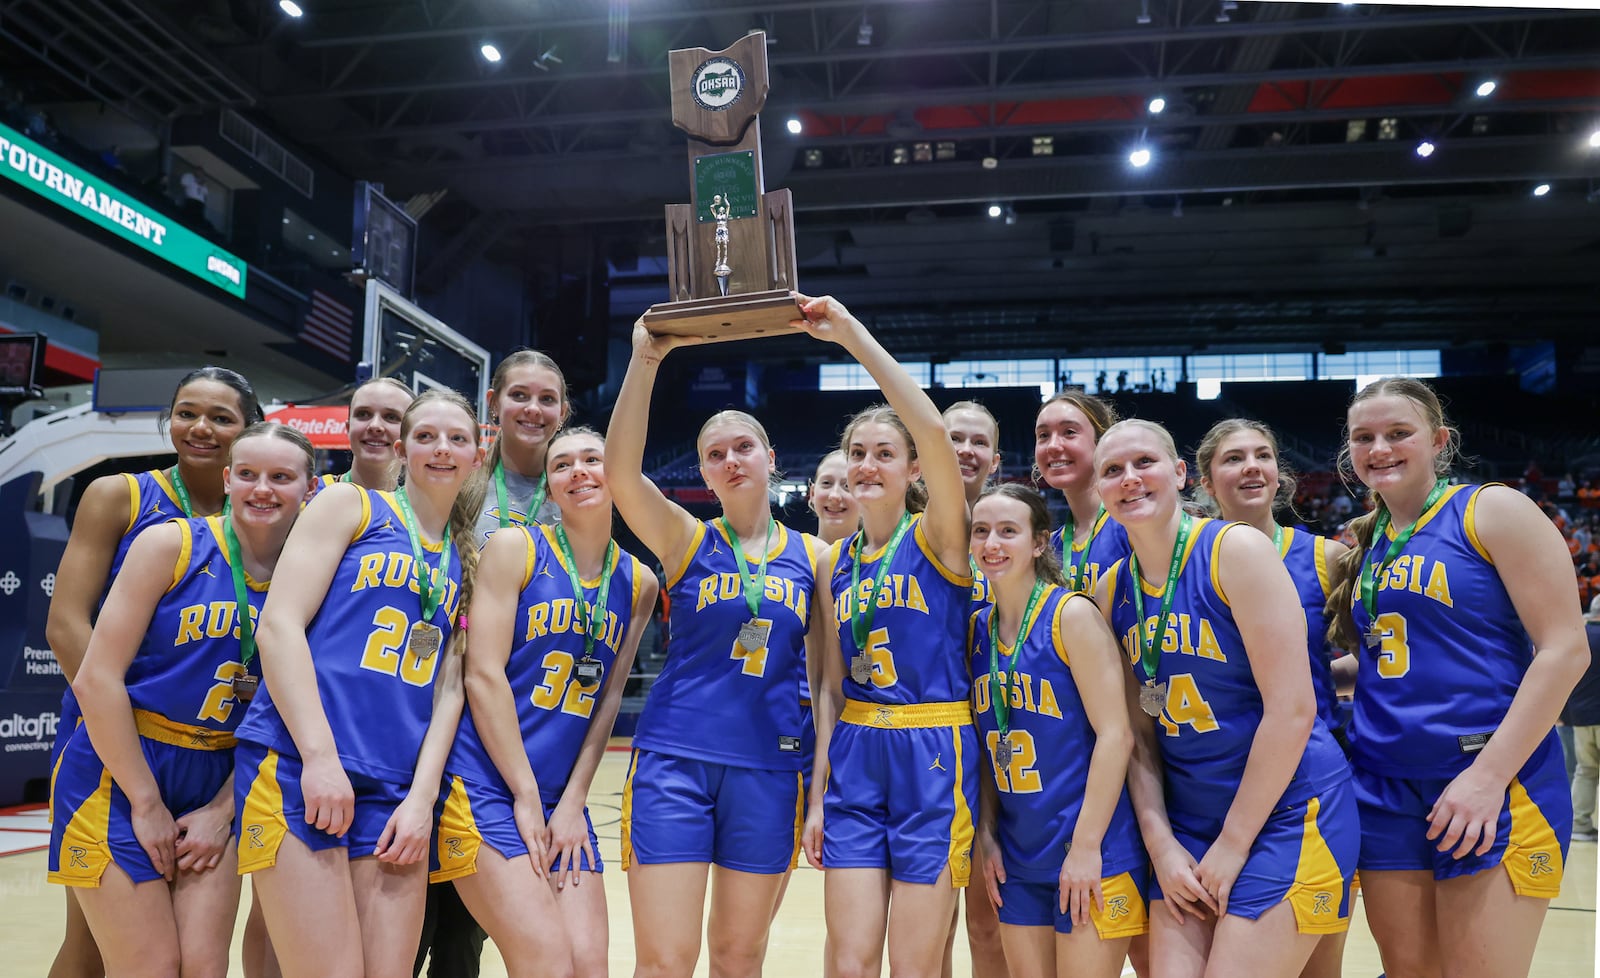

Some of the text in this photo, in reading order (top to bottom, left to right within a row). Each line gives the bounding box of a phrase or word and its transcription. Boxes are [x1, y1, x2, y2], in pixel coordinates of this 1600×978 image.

[700, 76, 736, 92] OHSAA
[0, 136, 166, 246] TOURNAMENT
[696, 572, 807, 628] RUSIA
[359, 605, 444, 688] 20
[729, 617, 774, 678] 4
[864, 626, 899, 689] 5
[1373, 612, 1411, 679] 3
[196, 660, 247, 724] 2
[529, 650, 605, 720] 32
[986, 729, 1044, 794] 12
[68, 845, 89, 869] R
[444, 836, 465, 860] R
[1528, 851, 1554, 876] R
[1107, 895, 1130, 919] R
[1313, 890, 1333, 915] R
